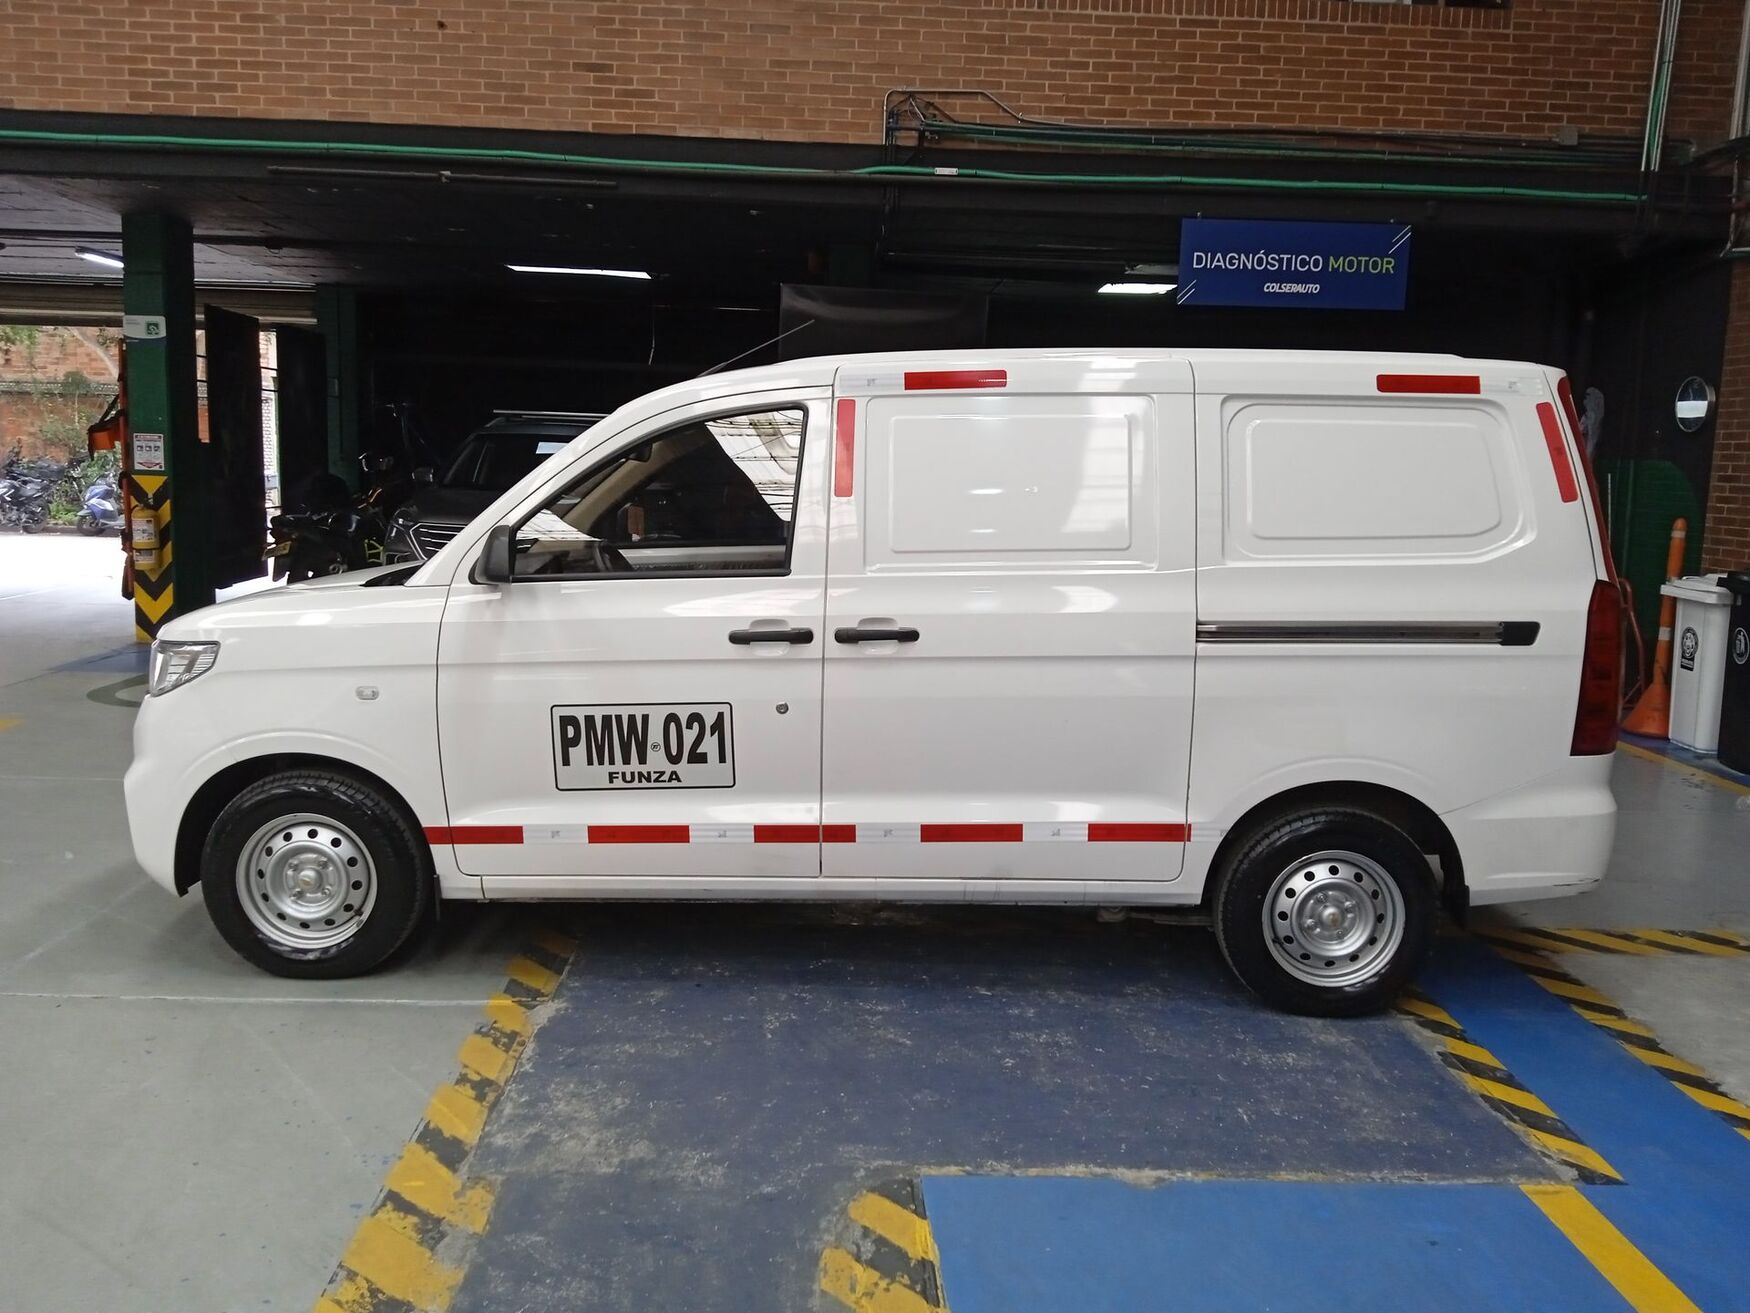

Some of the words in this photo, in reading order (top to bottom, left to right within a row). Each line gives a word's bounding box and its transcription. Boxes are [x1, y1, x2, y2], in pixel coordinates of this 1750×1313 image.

[1192, 250, 1323, 272] DIAGNÓSTICO
[1328, 255, 1395, 274] MOTOR
[1263, 282, 1320, 294] COLSERAUTO
[559, 714, 650, 766] PMW
[662, 711, 727, 765] 021
[608, 770, 682, 784] FUNZA
